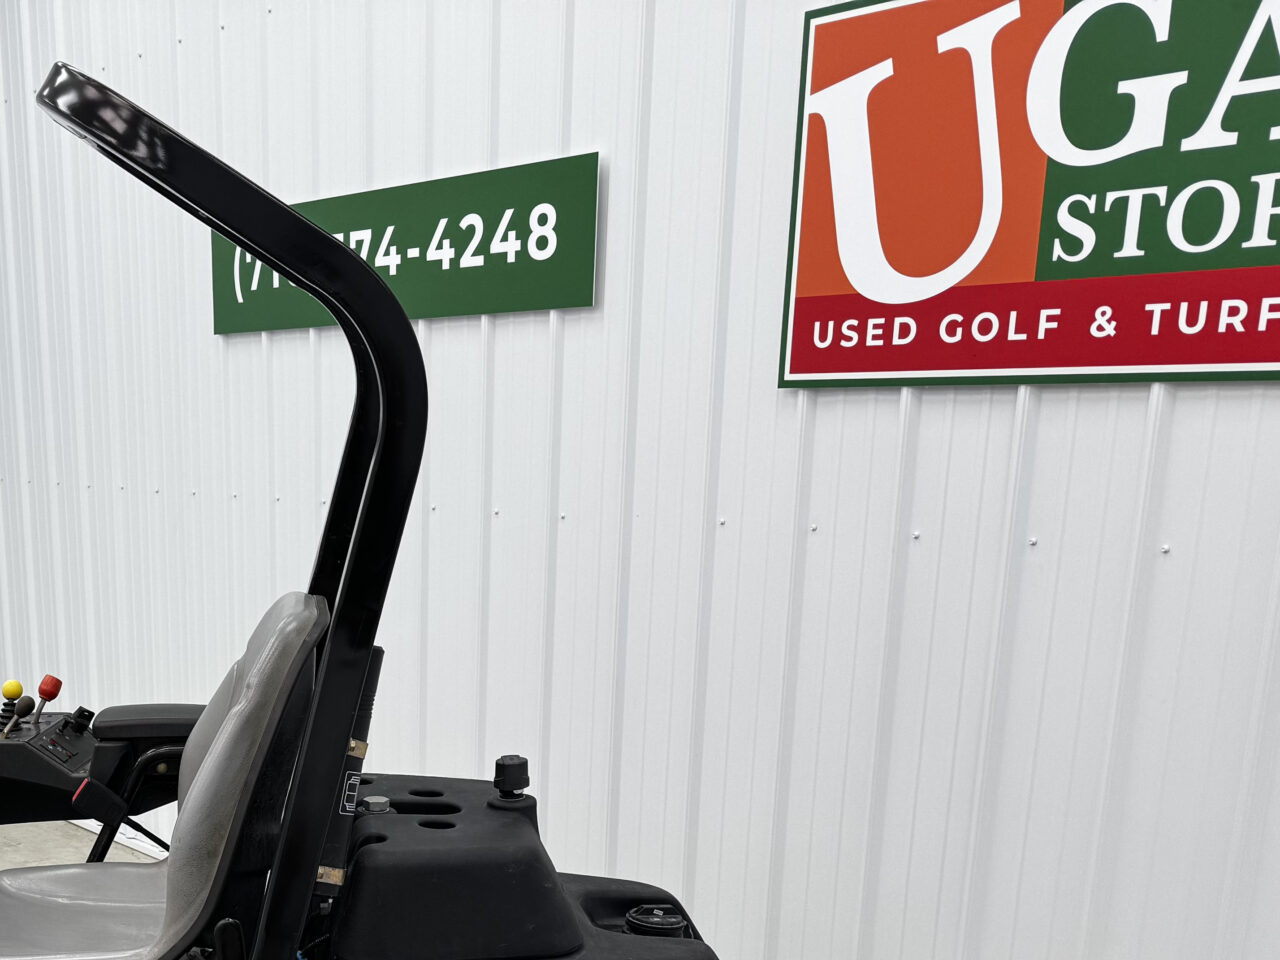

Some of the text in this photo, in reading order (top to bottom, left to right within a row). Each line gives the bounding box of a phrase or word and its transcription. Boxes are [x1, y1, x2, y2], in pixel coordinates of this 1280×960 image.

[332, 202, 557, 276] 74-4248
[813, 297, 1280, 349] USED GOLF & TURF
